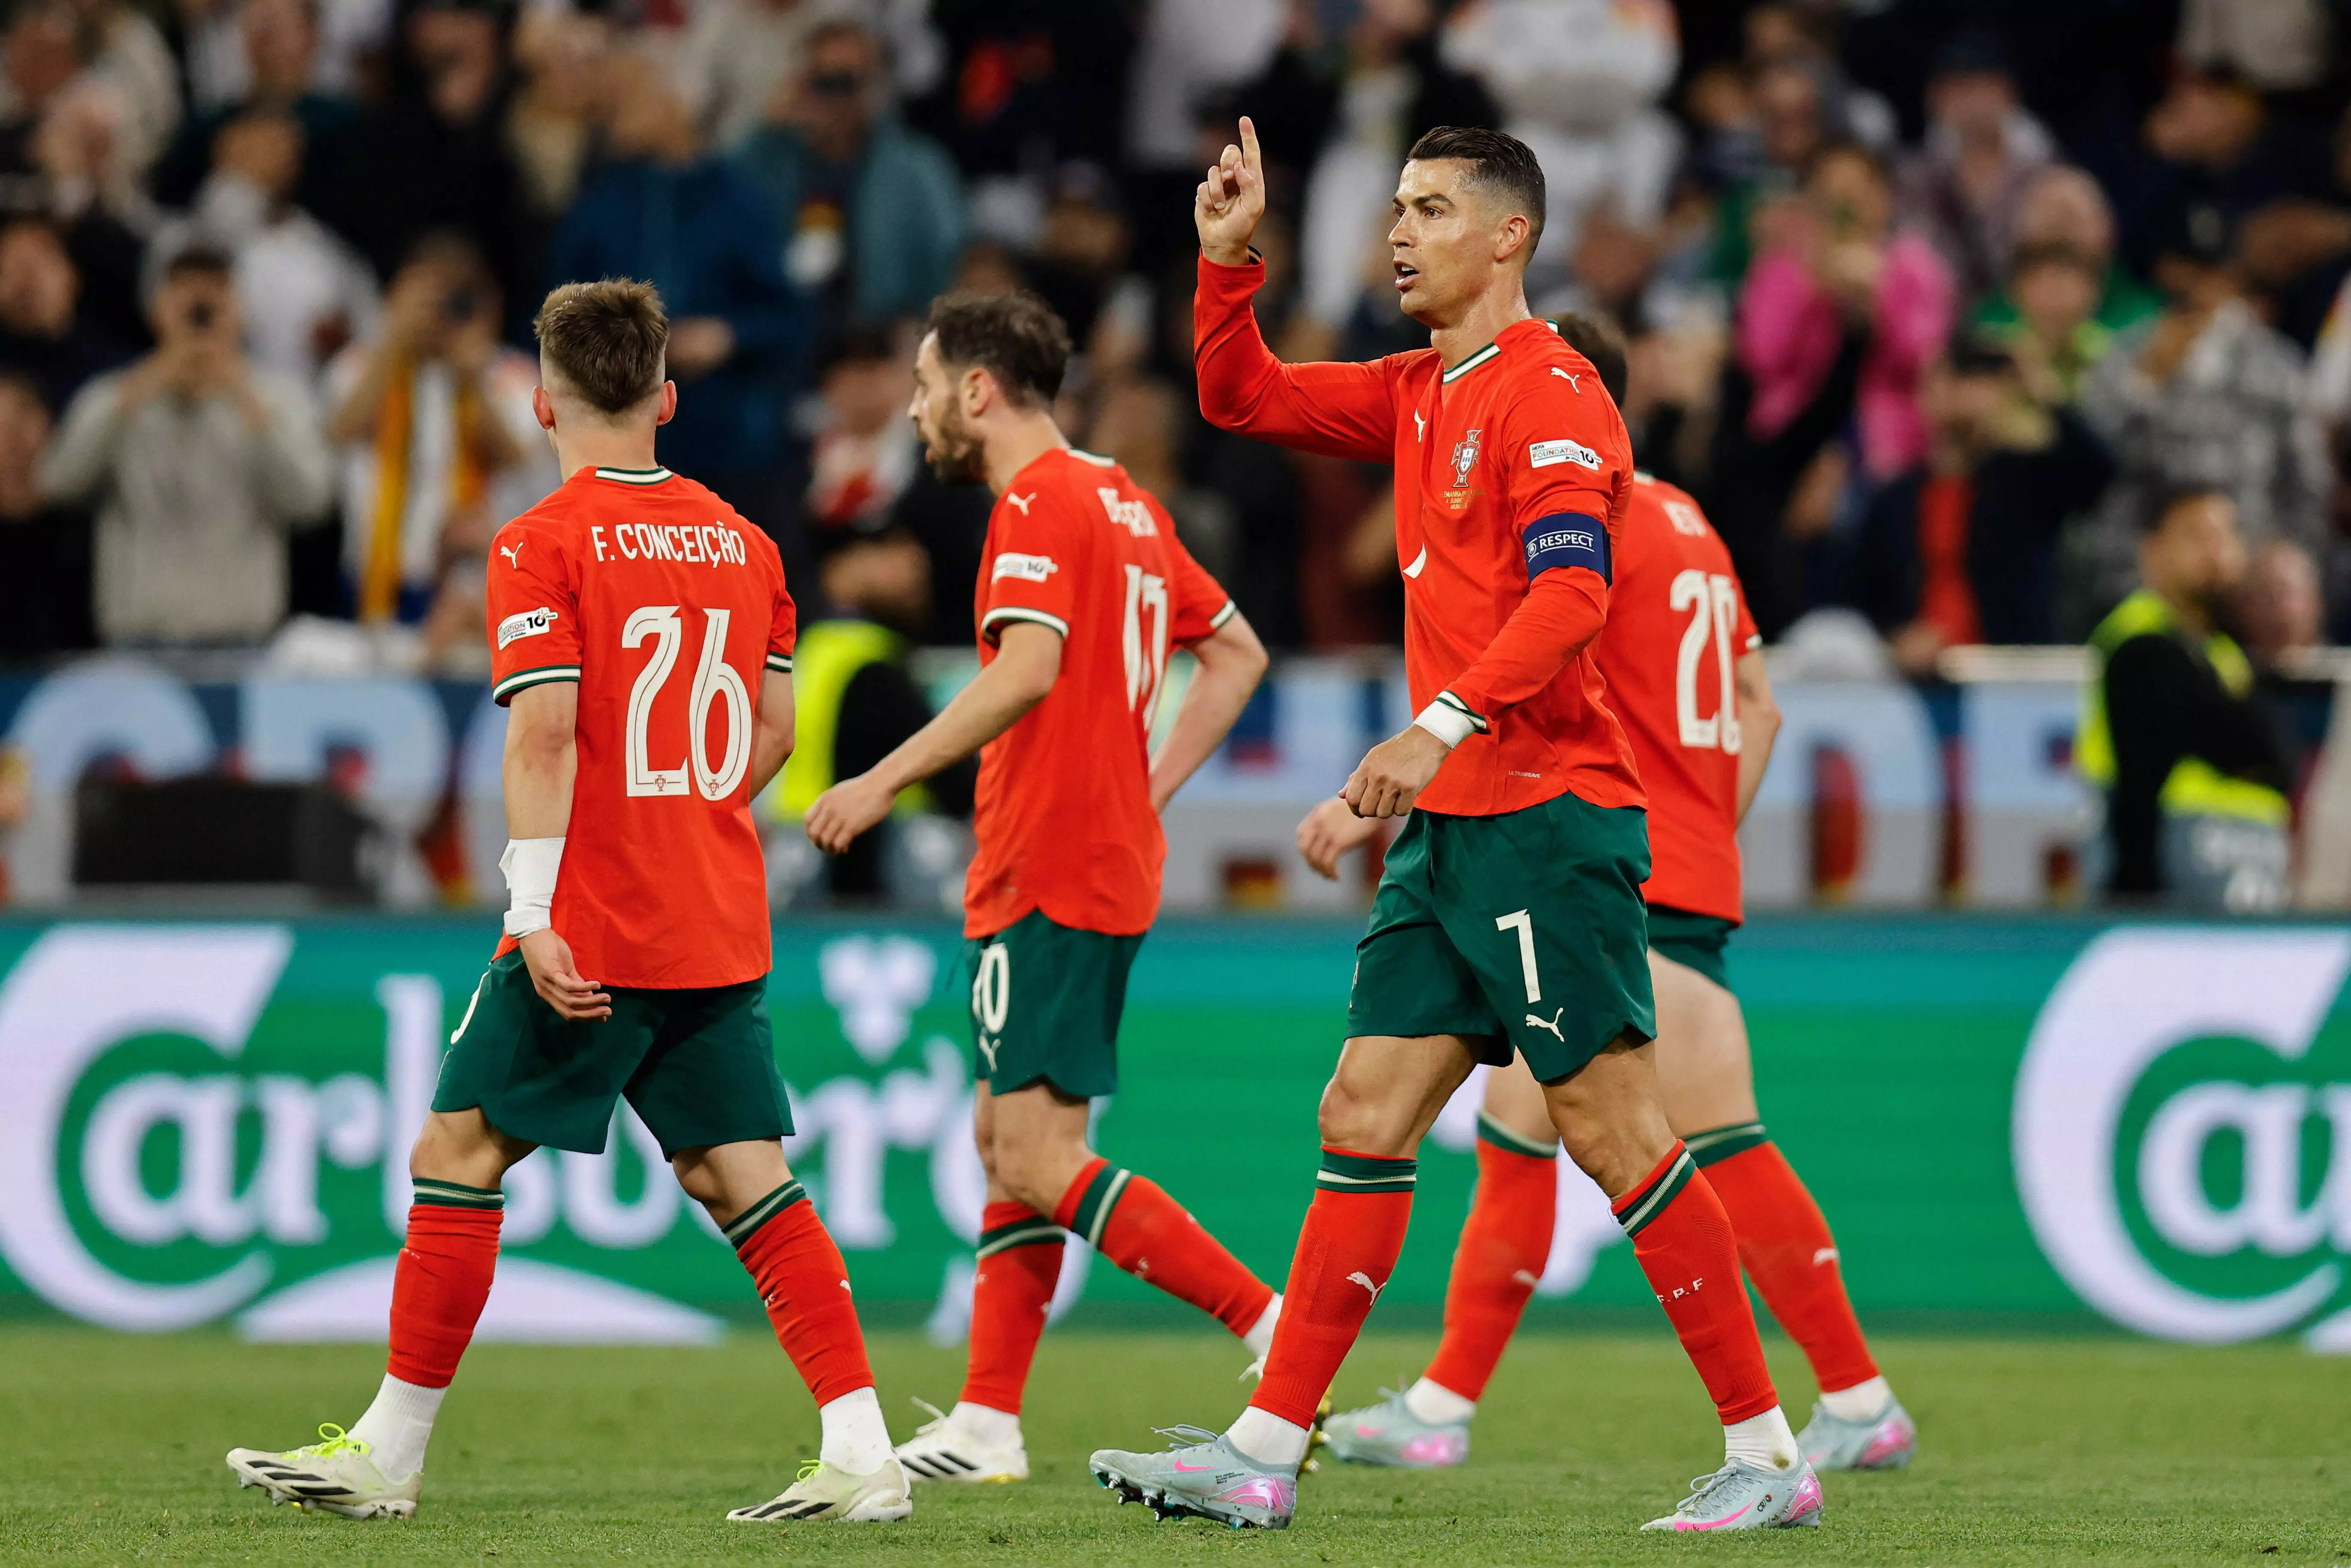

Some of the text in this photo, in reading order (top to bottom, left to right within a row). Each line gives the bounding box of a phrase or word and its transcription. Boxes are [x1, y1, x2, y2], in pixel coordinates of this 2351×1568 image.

[1532, 448, 1580, 460] FOUNDATION
[615, 520, 746, 568] CONCEIÇÃO
[1539, 534, 1593, 549] RESPECT
[526, 615, 546, 629] 10
[622, 606, 752, 801] 26
[1508, 770, 1541, 778] ULTRAWEAVE
[1496, 908, 1541, 1003] 7
